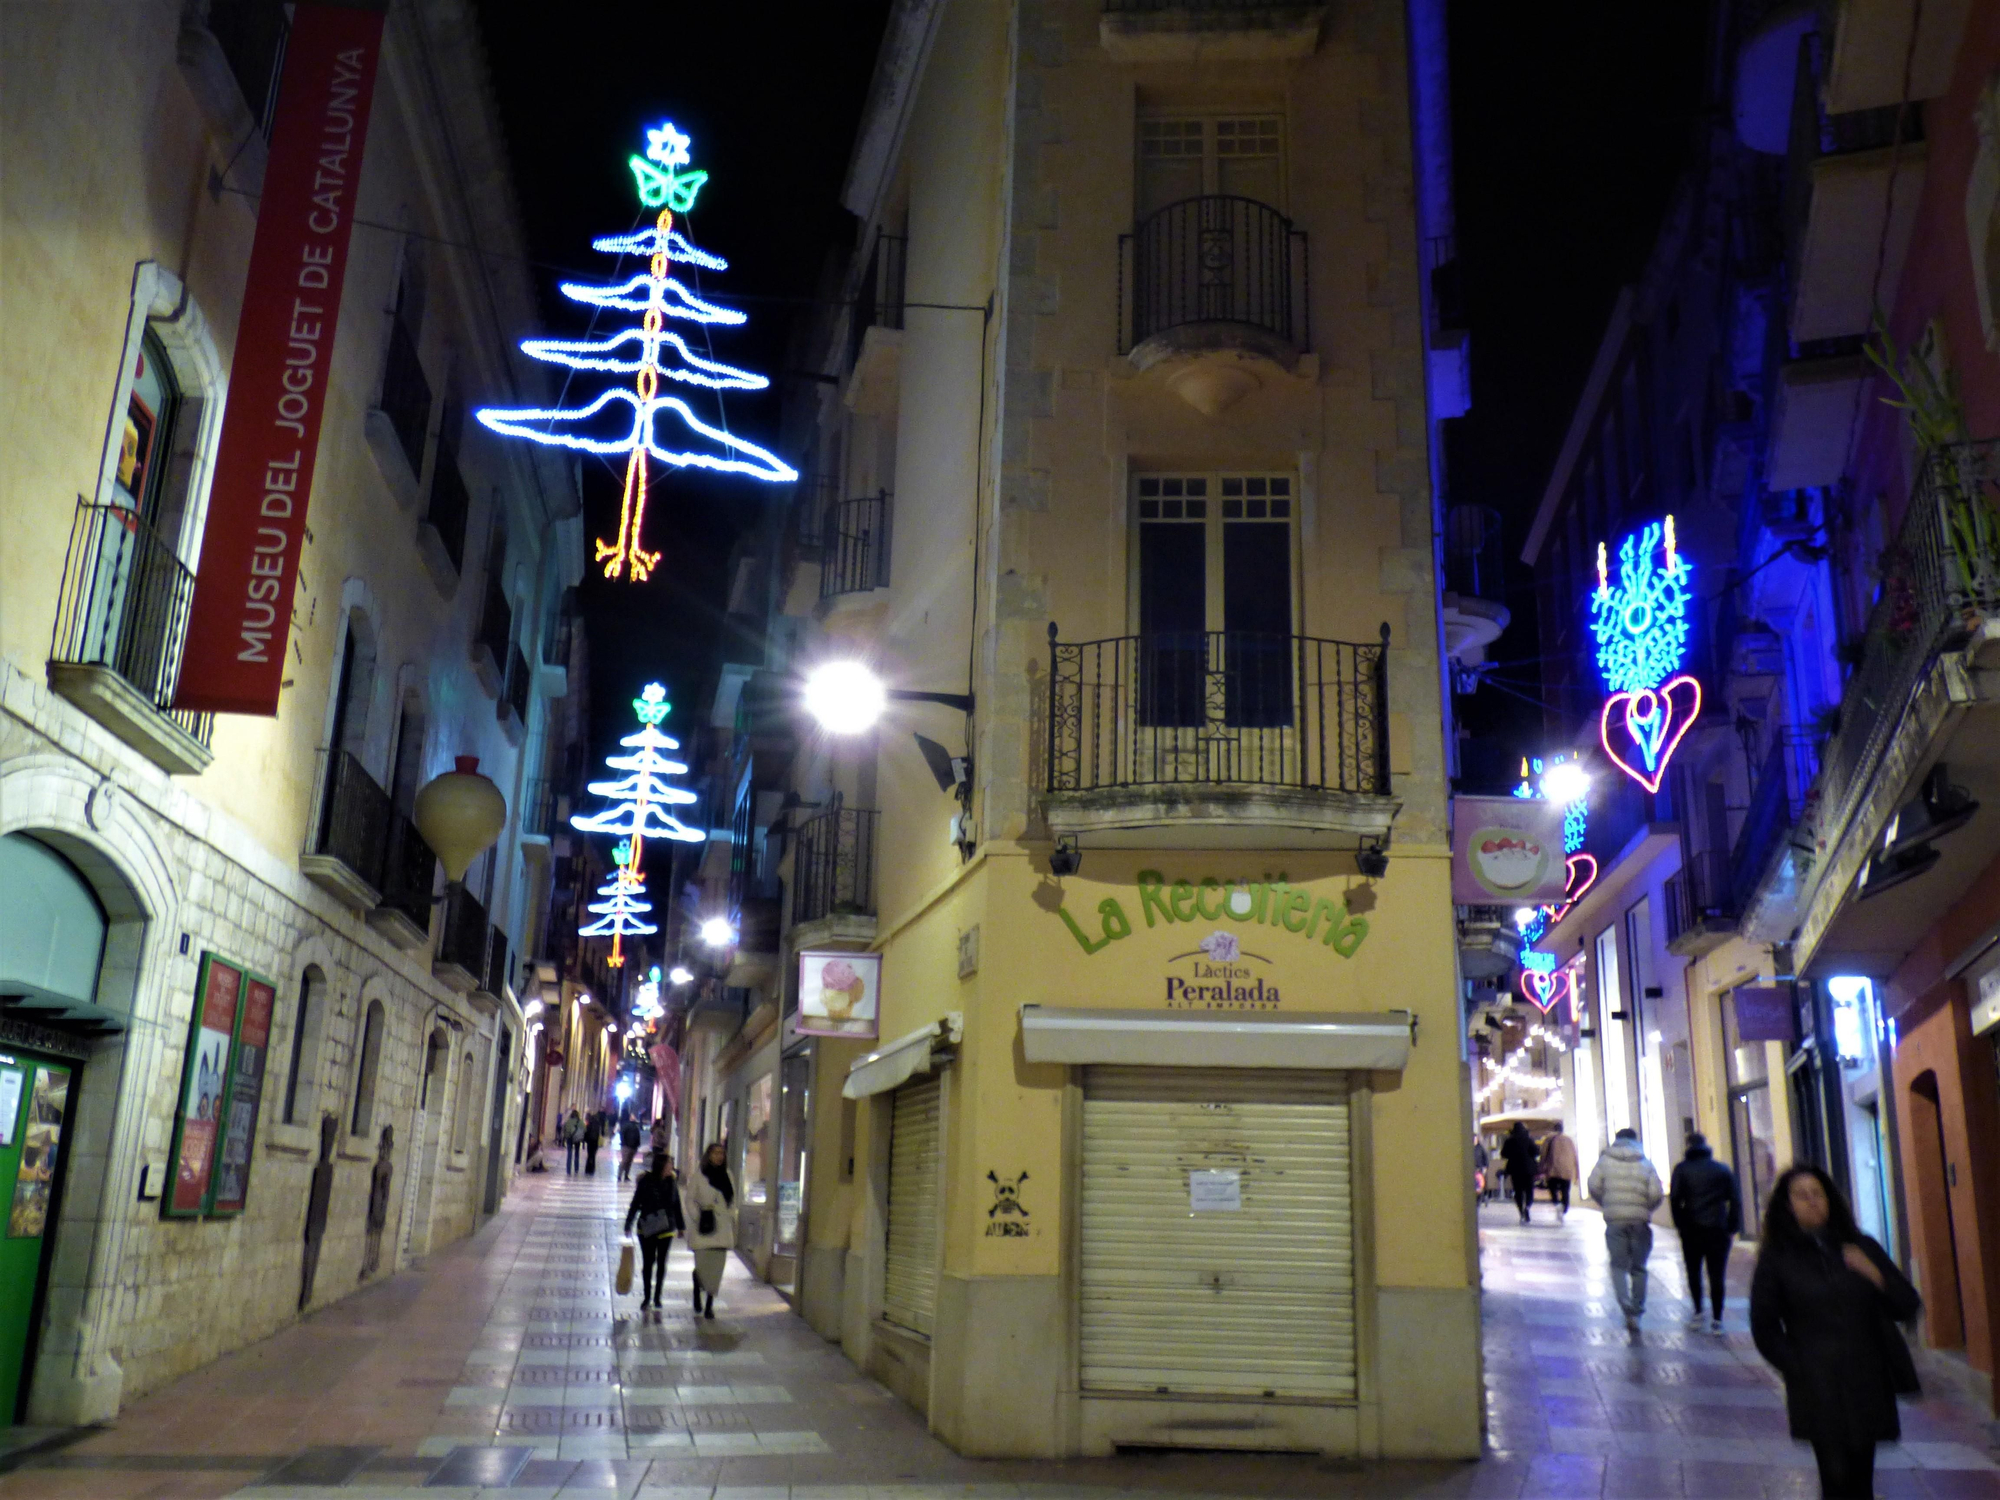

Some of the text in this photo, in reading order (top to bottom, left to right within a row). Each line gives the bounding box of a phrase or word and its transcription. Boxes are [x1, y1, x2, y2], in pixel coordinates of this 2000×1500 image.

[237, 47, 366, 663] MUSEU DEL JOGUET DE CATALUNYA
[1059, 897, 1132, 956] La
[1165, 977, 1281, 1002] Peralada
[1193, 961, 1251, 979] Làctics
